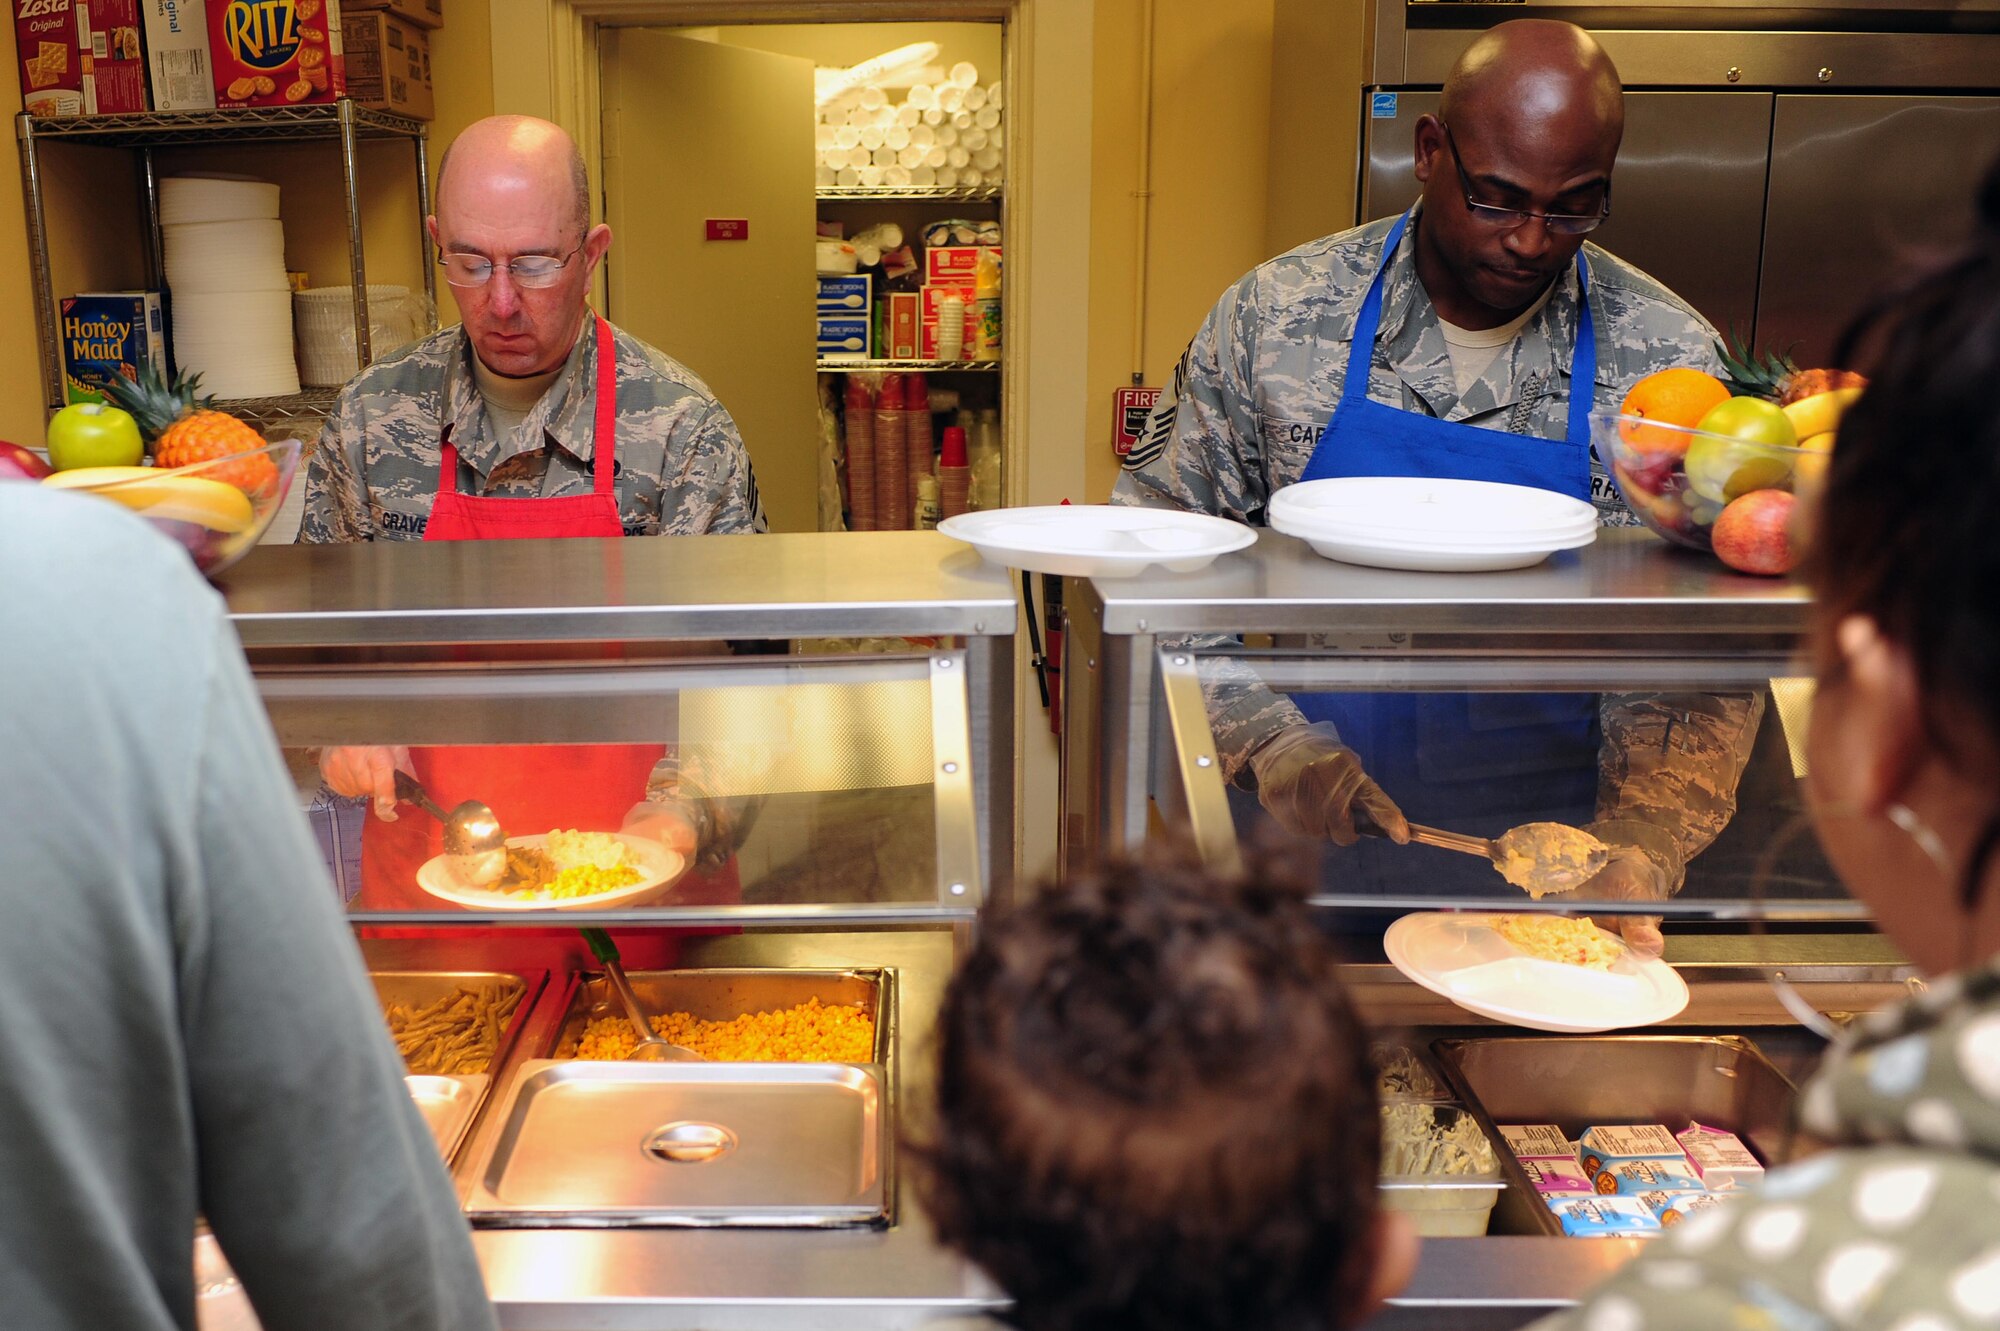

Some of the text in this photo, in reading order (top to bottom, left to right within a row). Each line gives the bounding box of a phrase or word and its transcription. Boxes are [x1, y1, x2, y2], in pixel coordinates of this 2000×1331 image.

[18, 0, 69, 19] Zesta
[165, 0, 181, 33] ginal
[30, 17, 64, 32] Original
[228, 0, 299, 61] RITZ
[65, 317, 130, 342] Honey
[73, 338, 123, 360] Maid
[1124, 392, 1160, 406] FIRE
